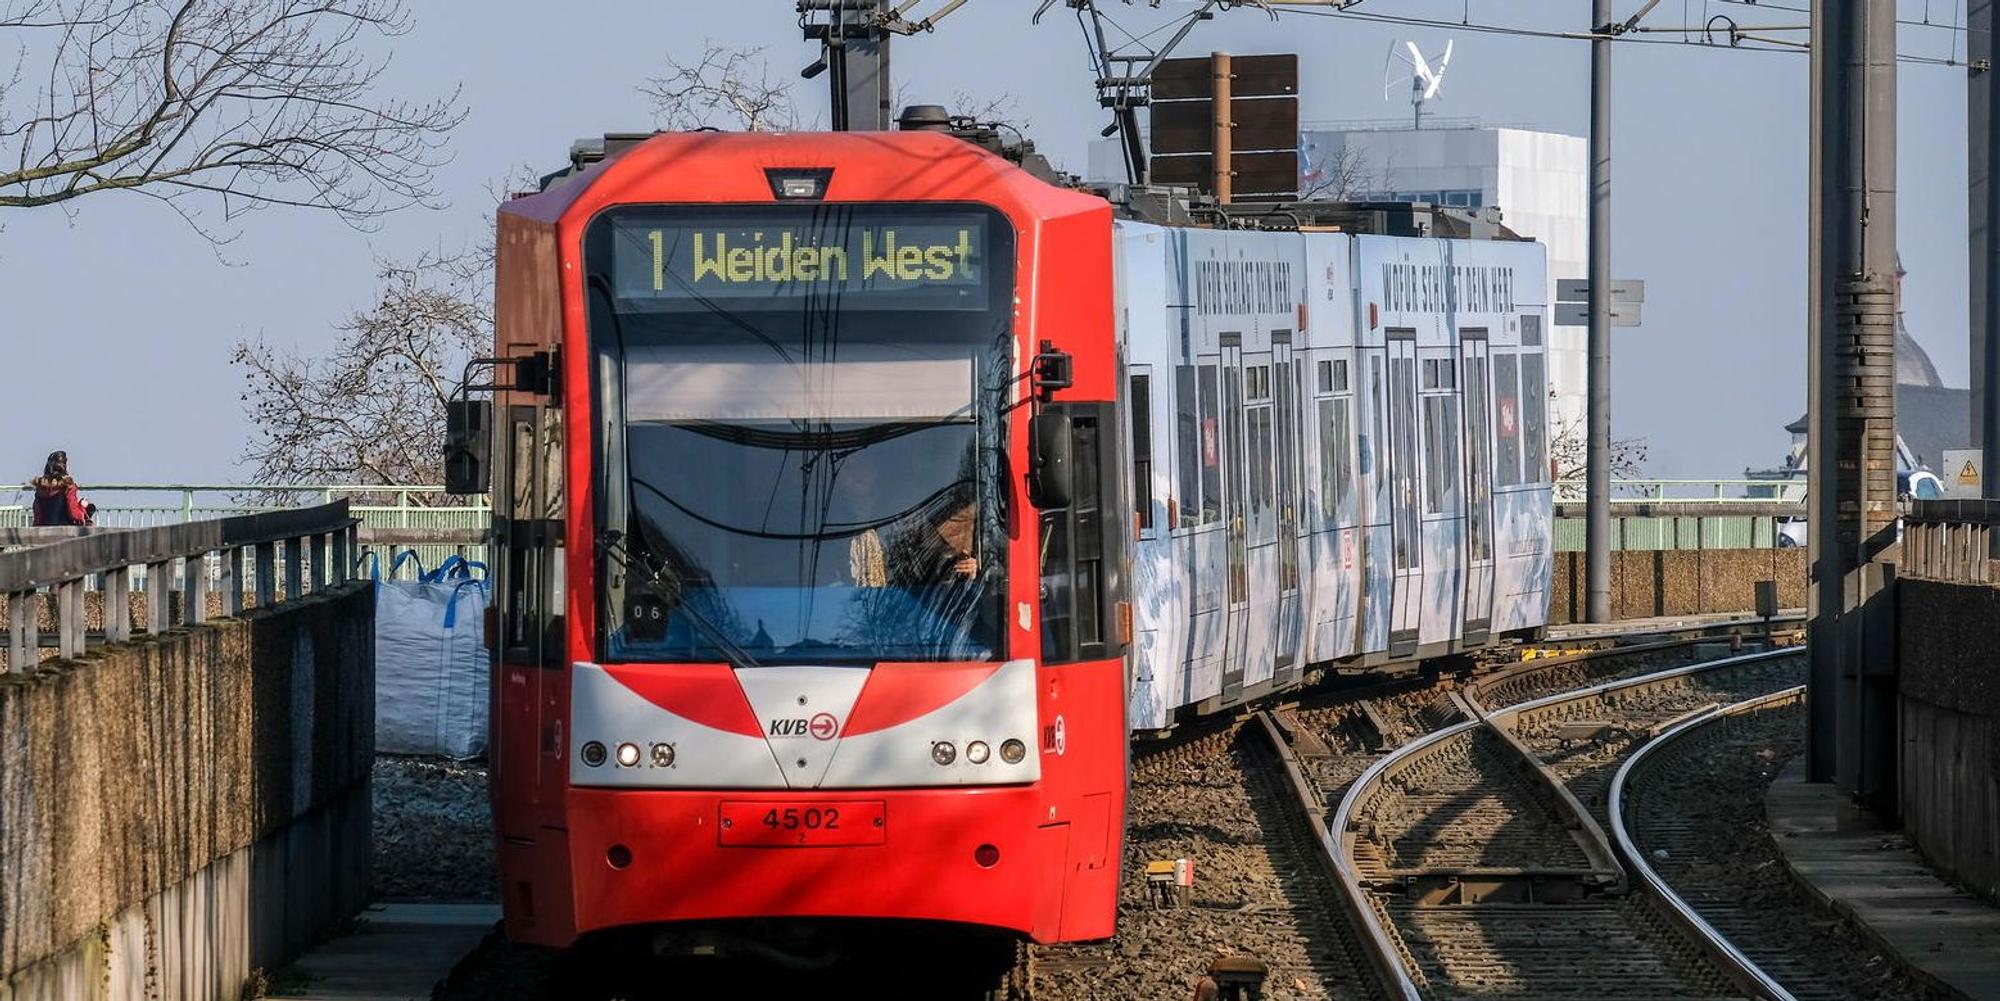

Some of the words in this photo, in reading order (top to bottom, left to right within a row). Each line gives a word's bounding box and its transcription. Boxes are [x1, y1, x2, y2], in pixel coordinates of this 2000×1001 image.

[649, 230, 663, 290] 1
[694, 232, 848, 282] Weiden
[863, 230, 974, 281] West
[1195, 248, 1223, 316] WOFÜR
[1255, 261, 1273, 315] DEIN
[1382, 252, 1418, 313] WOFÜR
[1466, 266, 1488, 313] DEIN
[1491, 266, 1514, 313] HERZ
[769, 719, 809, 736] KVB
[762, 808, 840, 830] 4502
[798, 832, 806, 843] 2
